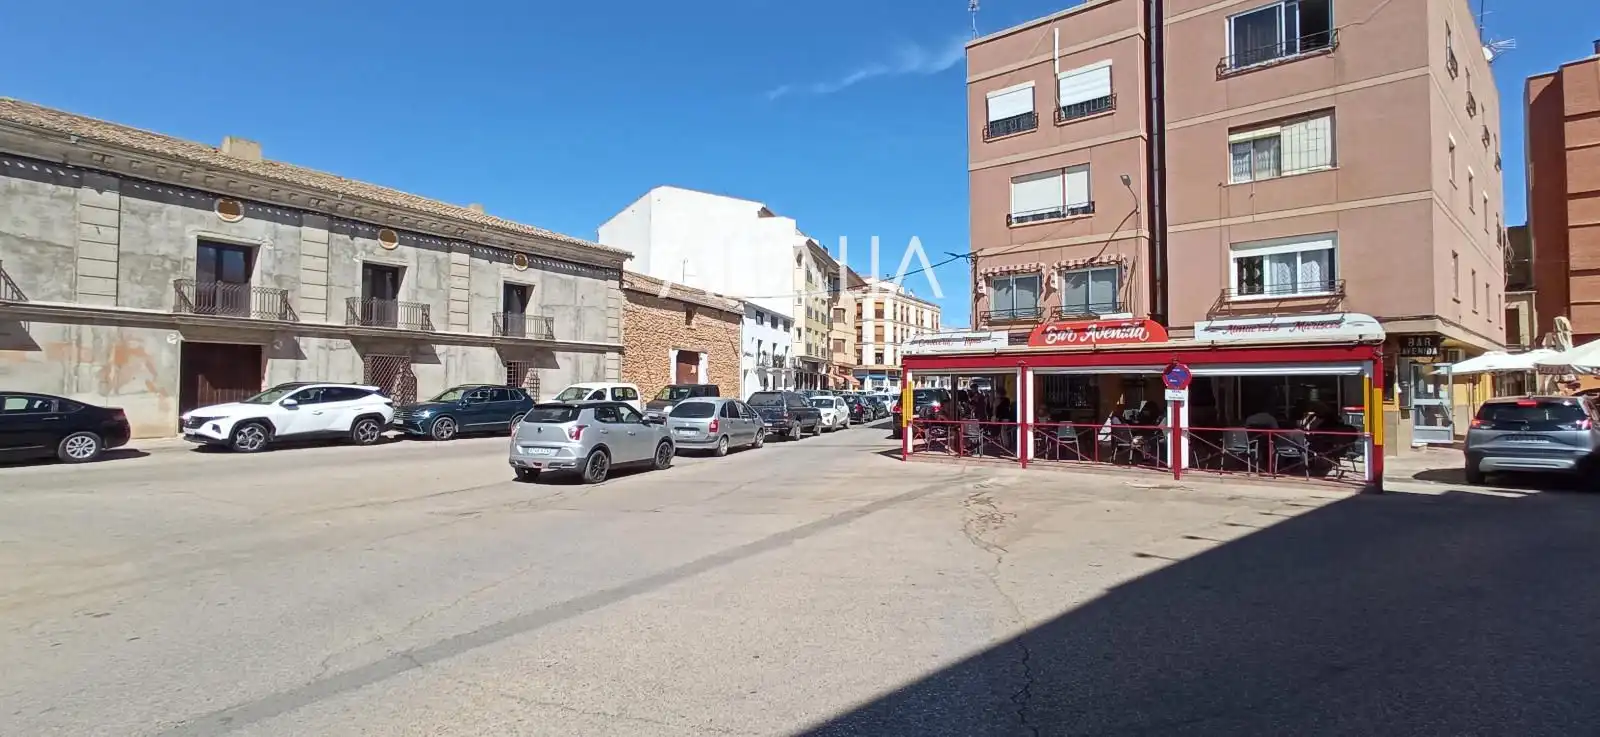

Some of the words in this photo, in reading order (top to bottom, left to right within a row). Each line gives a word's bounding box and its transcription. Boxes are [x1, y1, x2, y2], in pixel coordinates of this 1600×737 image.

[1045, 325, 1077, 344] Bar
[1080, 322, 1149, 342] Avenida
[1408, 337, 1431, 346] BAR
[1402, 347, 1438, 355] AVENIDA
